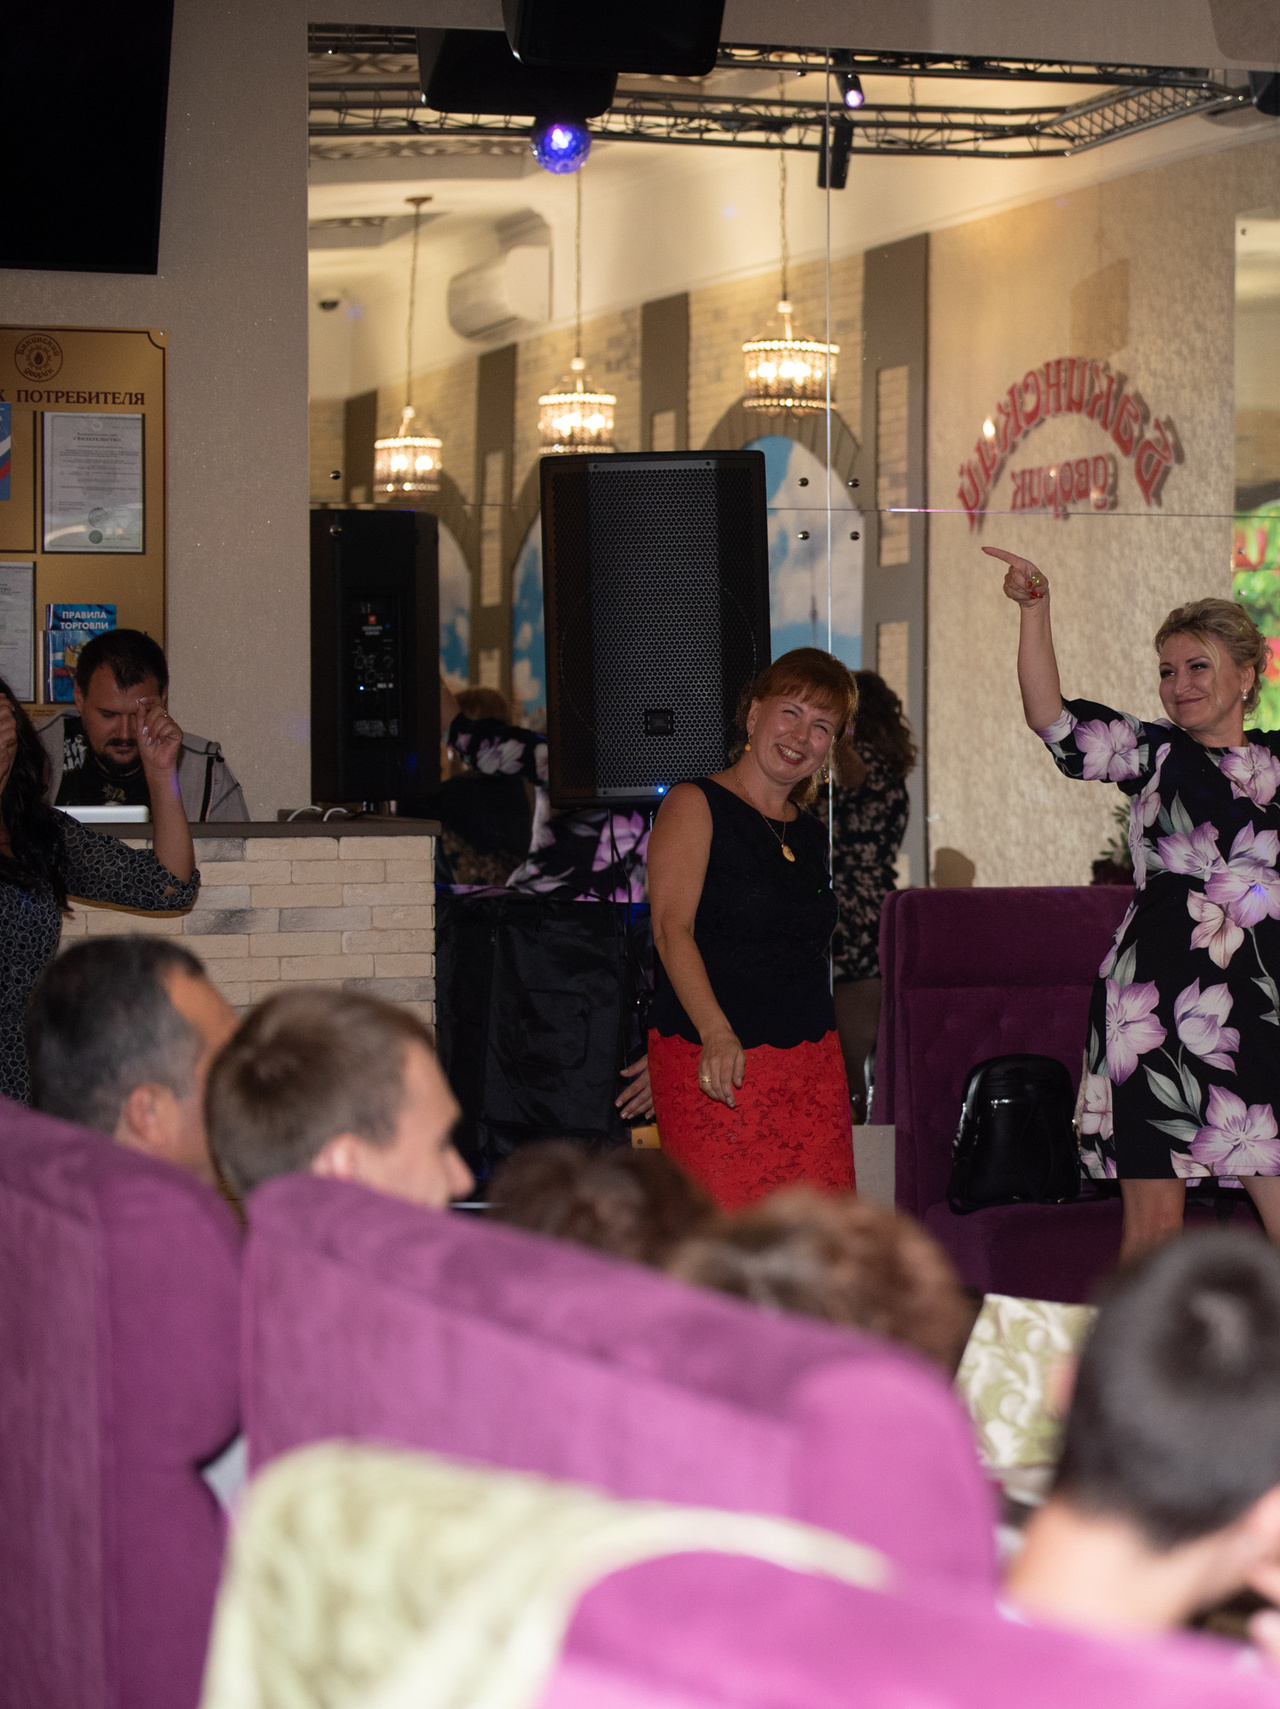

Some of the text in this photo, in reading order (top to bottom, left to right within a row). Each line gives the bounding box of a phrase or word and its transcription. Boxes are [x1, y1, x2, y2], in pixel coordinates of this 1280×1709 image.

[16, 389, 145, 405] ПОТРЕБИТЕЛЯ
[62, 611, 107, 619] ПРАВИЛА
[60, 622, 109, 630] ТОРГОВЛИ
